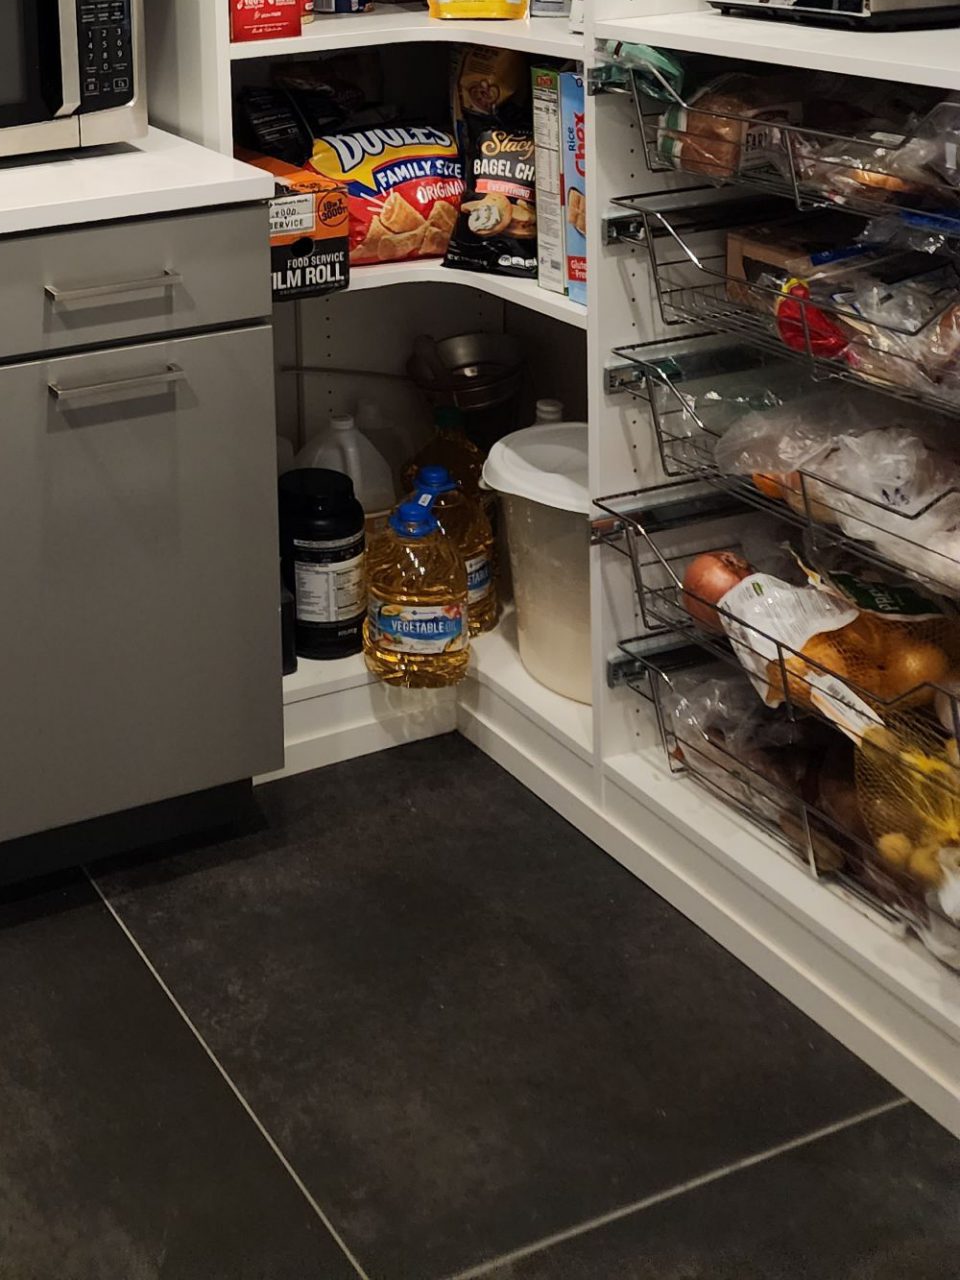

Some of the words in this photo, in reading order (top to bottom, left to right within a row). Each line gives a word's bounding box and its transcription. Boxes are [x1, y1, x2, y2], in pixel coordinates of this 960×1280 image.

[376, 160, 432, 188] FAMILY
[436, 159, 462, 178] SIZE
[473, 158, 512, 178] BAGEL
[515, 163, 536, 182] CH
[287, 256, 309, 269] FOOD
[311, 252, 344, 266] SERVICE
[570, 259, 587, 269] Glute
[305, 262, 344, 286] ROLL
[391, 619, 445, 634] VEGETABLE
